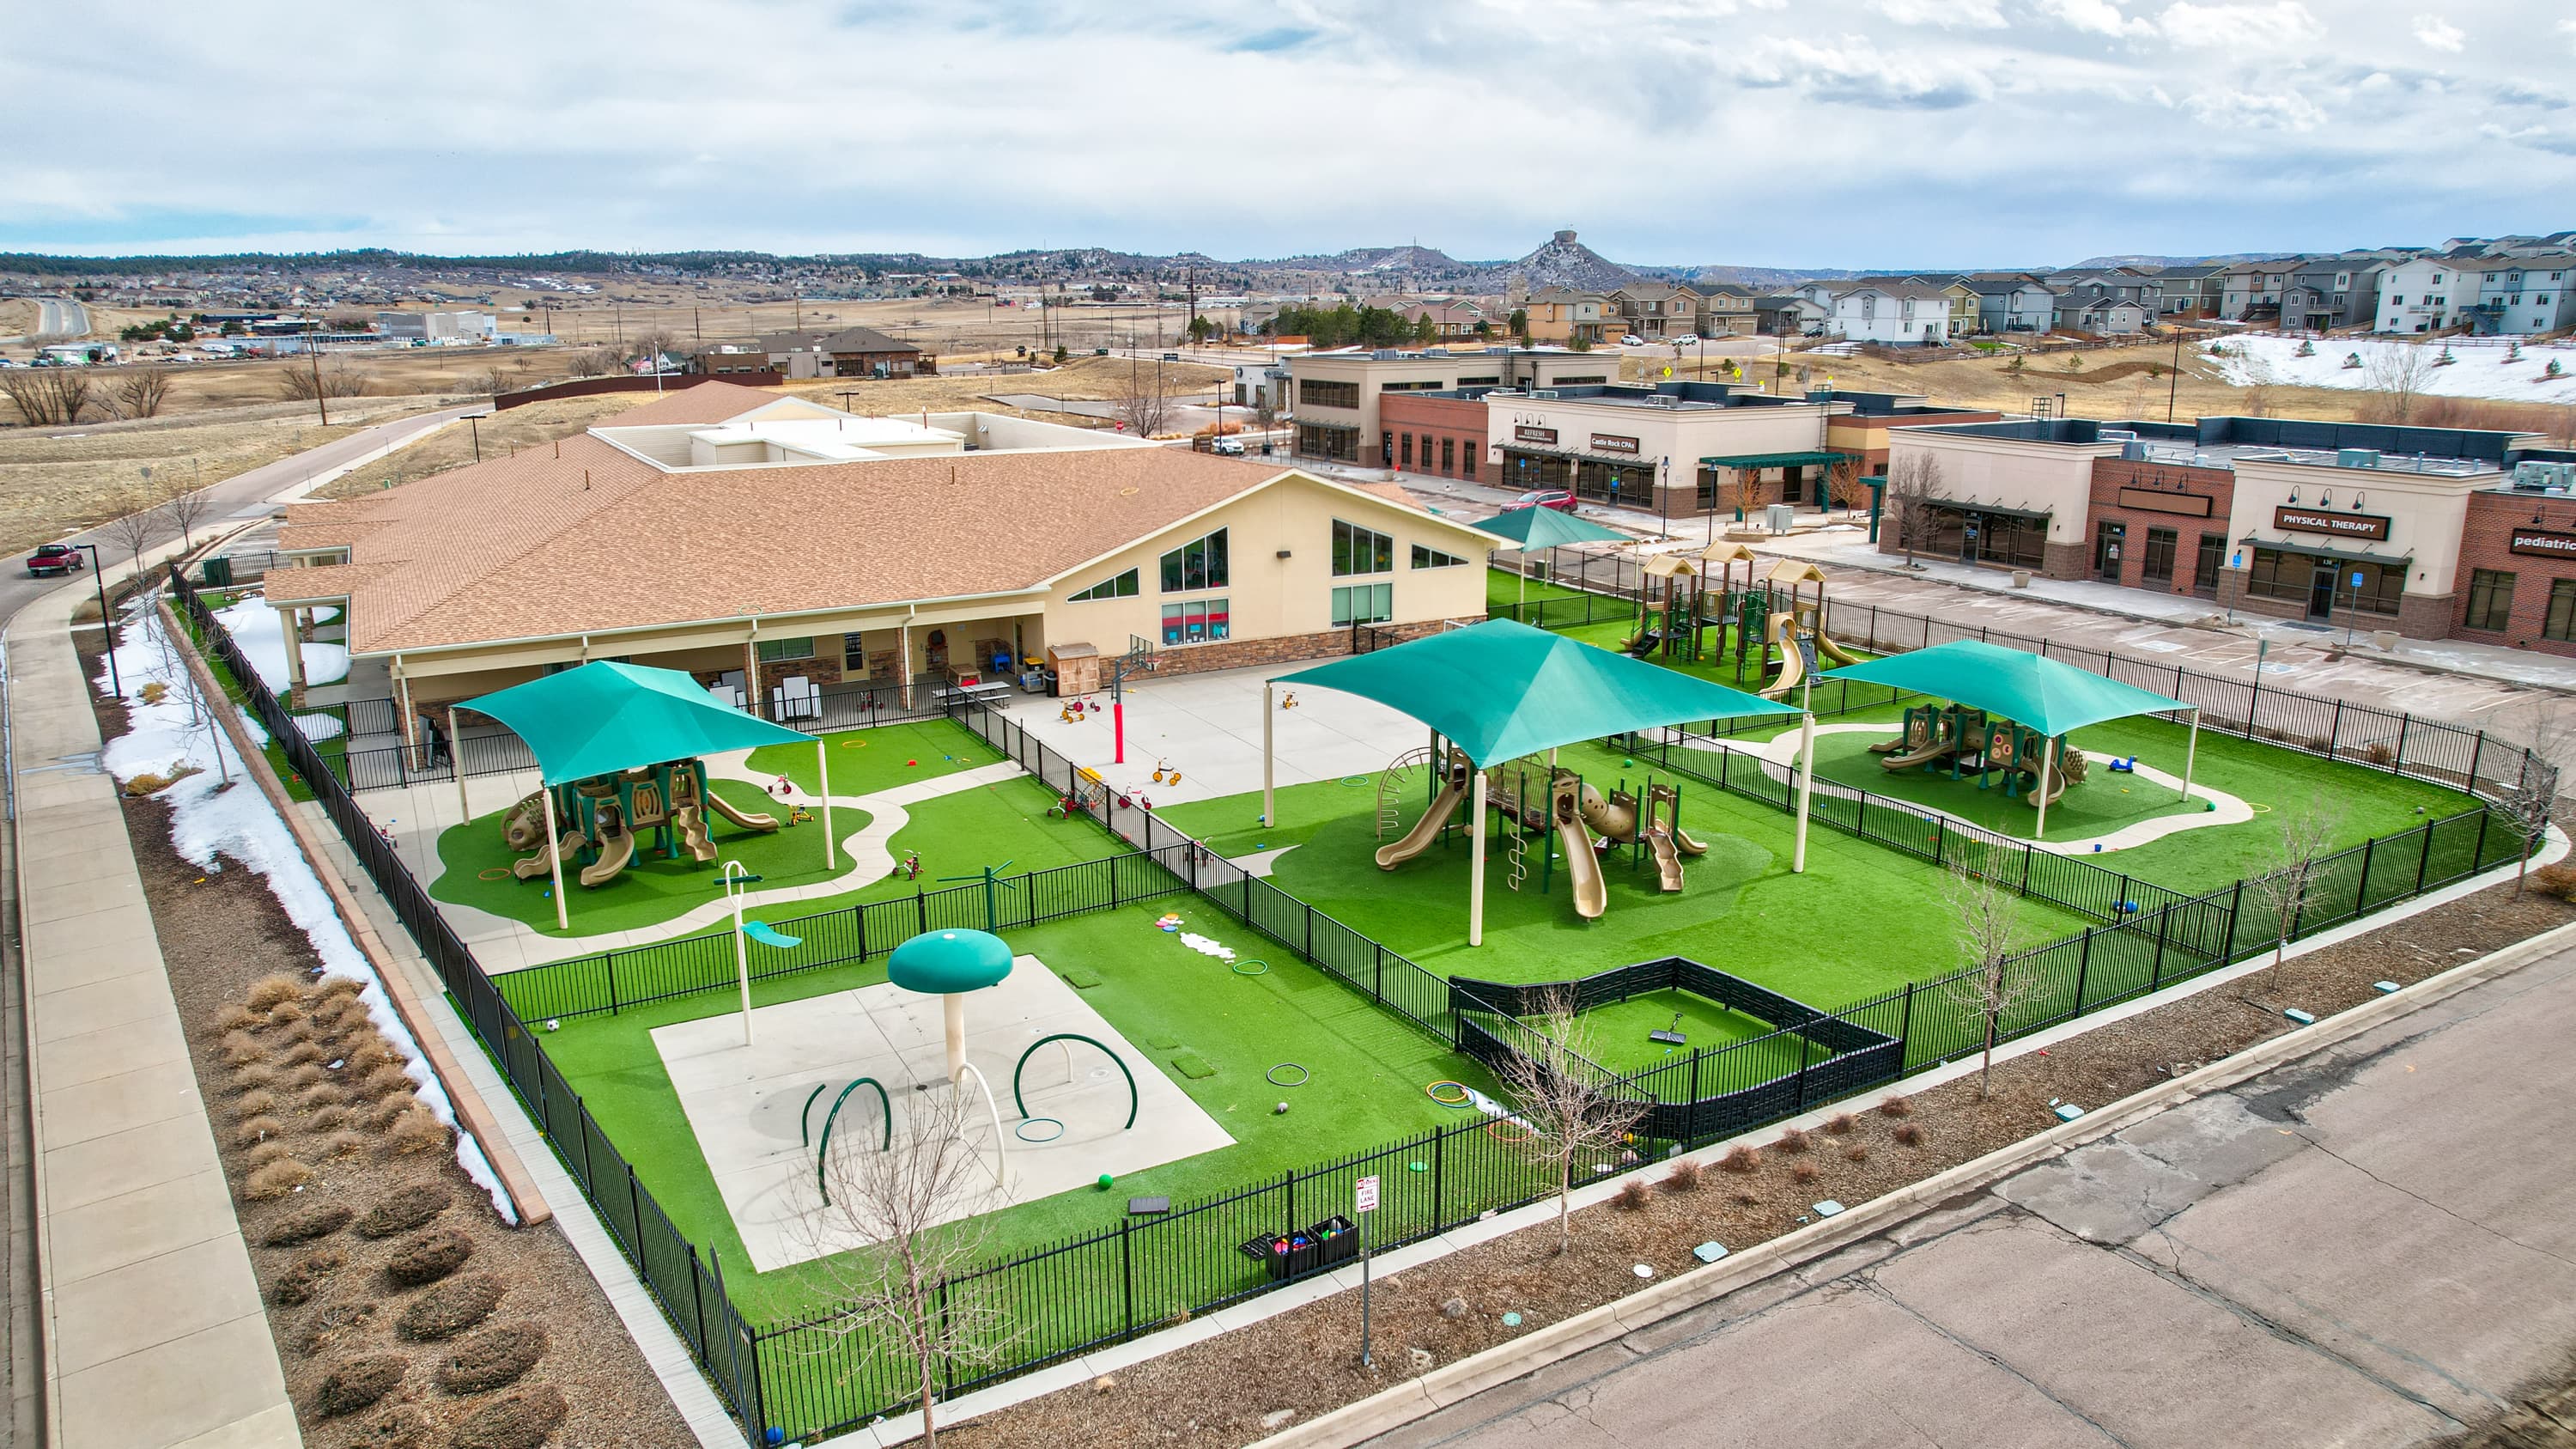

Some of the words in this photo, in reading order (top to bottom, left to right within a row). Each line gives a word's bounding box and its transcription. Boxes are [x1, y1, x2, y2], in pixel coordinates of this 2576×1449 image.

[1524, 429, 1545, 437] REFRESH
[2283, 514, 2328, 527] PHYSICAL
[2330, 520, 2377, 533] THERAPY
[2513, 536, 2576, 551] pediatric
